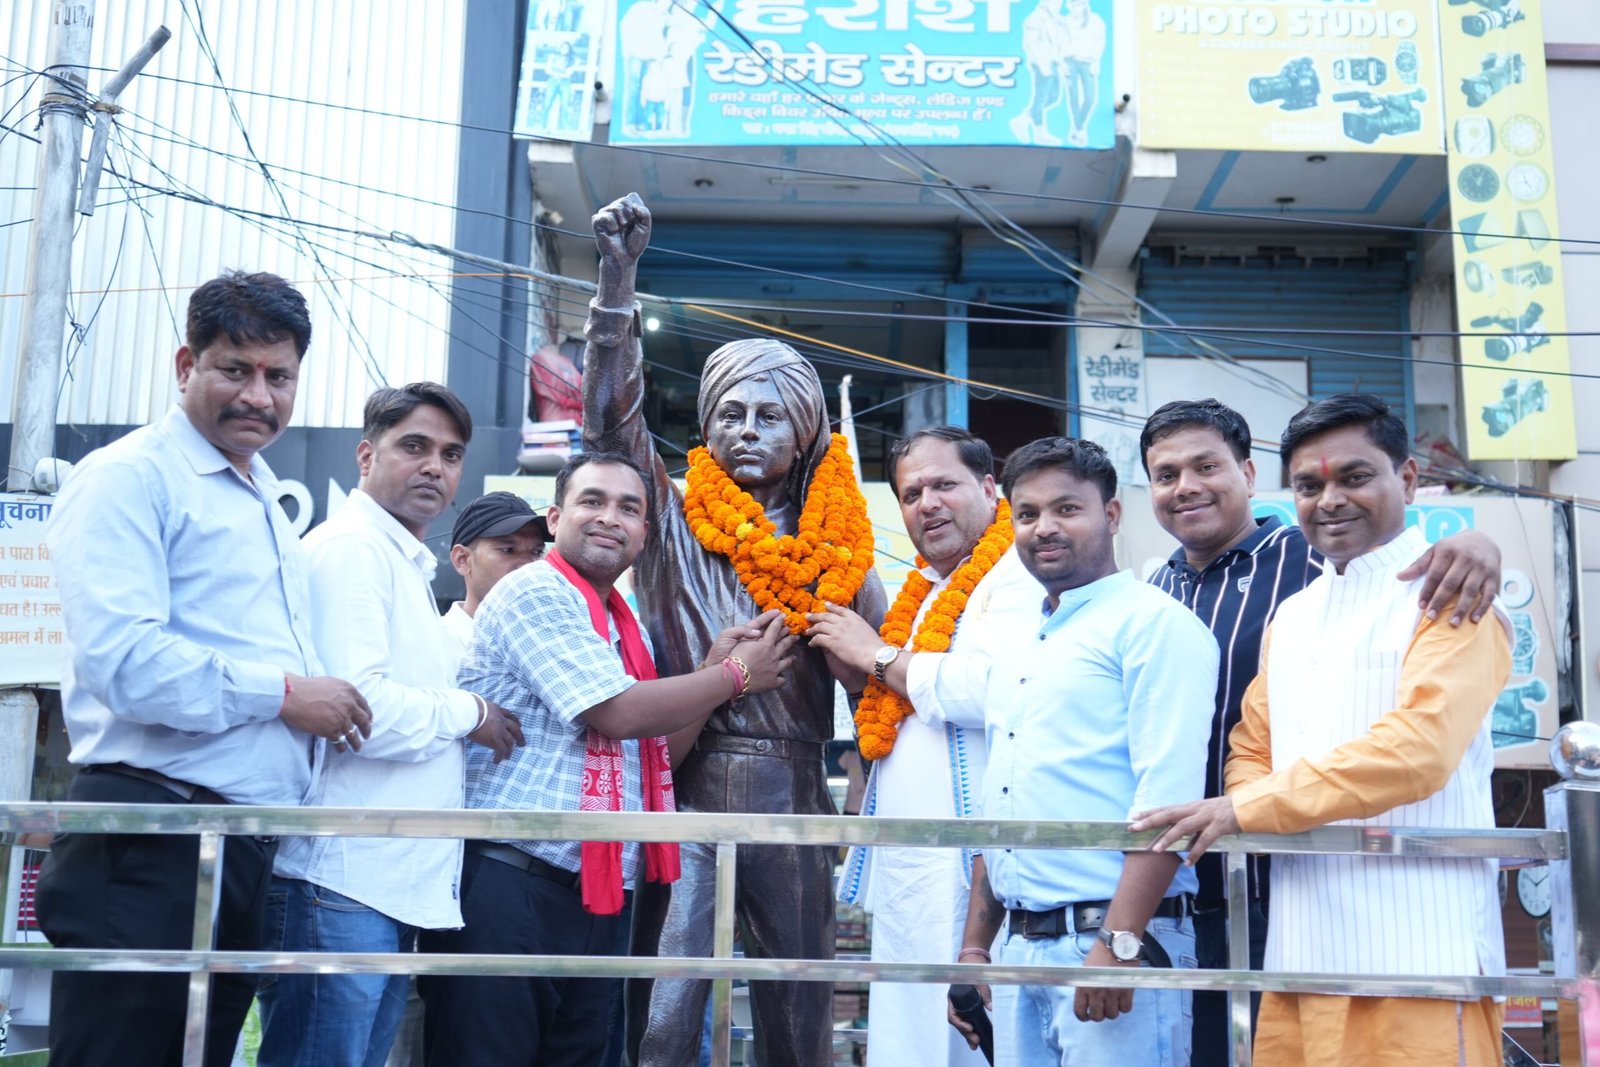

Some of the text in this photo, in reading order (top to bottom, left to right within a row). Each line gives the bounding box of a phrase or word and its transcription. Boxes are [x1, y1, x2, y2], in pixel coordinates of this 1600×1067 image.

[1152, 5, 1418, 39] PHOTO STUDIO
[704, 41, 1022, 89] रेडीमेड सेन्टर
[1089, 380, 1138, 402] सेन्टर
[10, 546, 34, 561] पास
[21, 575, 51, 589] प्रचार
[33, 626, 44, 645] में
